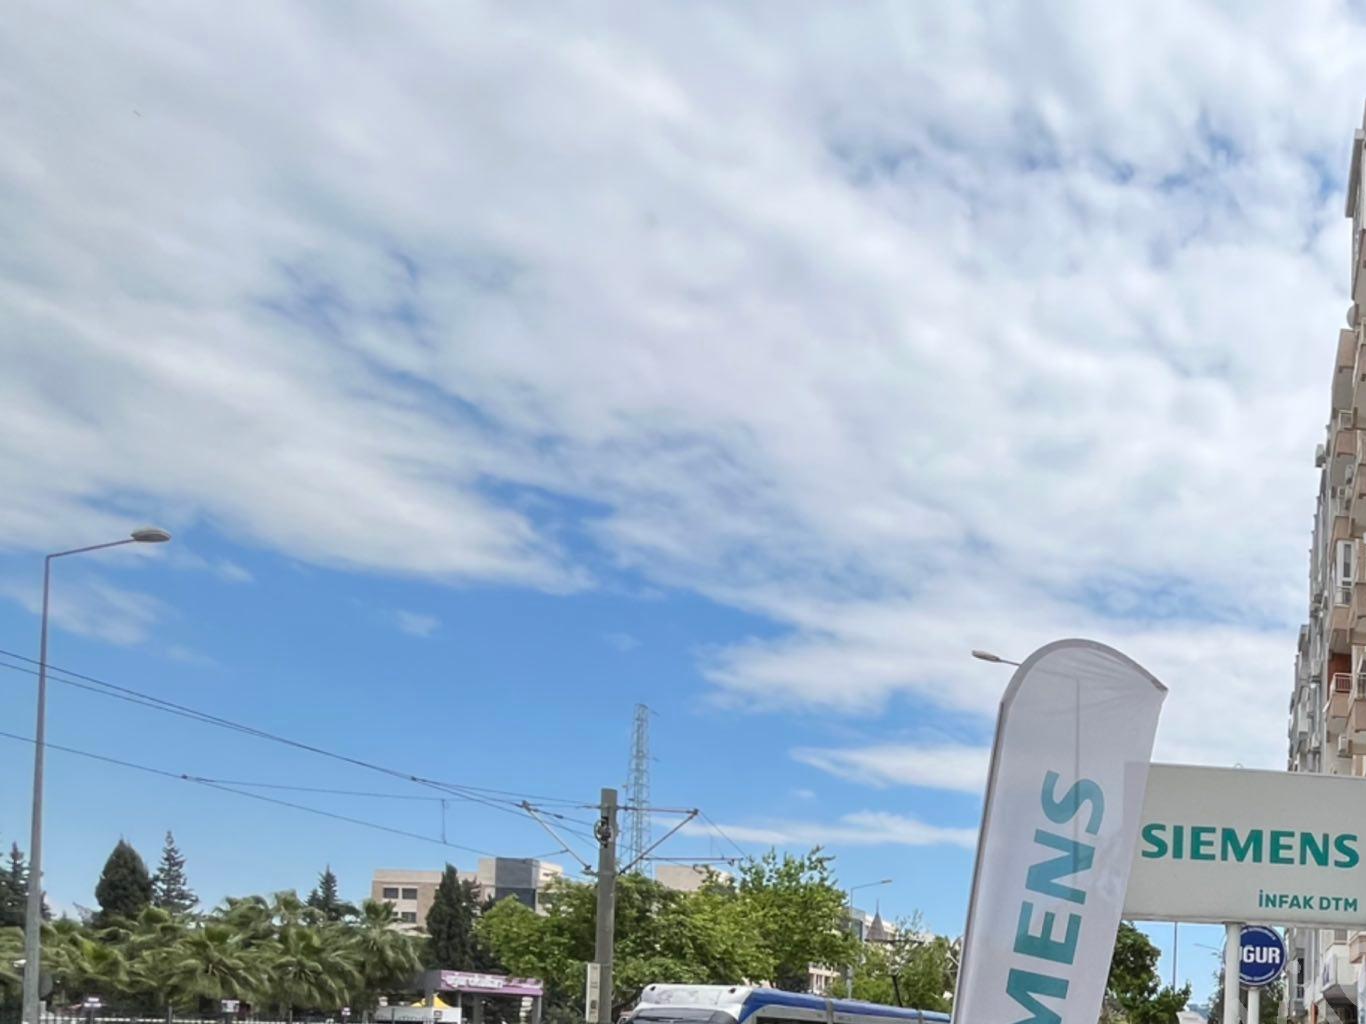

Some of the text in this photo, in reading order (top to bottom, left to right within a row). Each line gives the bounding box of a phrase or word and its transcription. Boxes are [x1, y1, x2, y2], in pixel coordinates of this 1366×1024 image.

[1141, 823, 1360, 868] SIEMENS
[1259, 889, 1359, 913] İNFAK DTM
